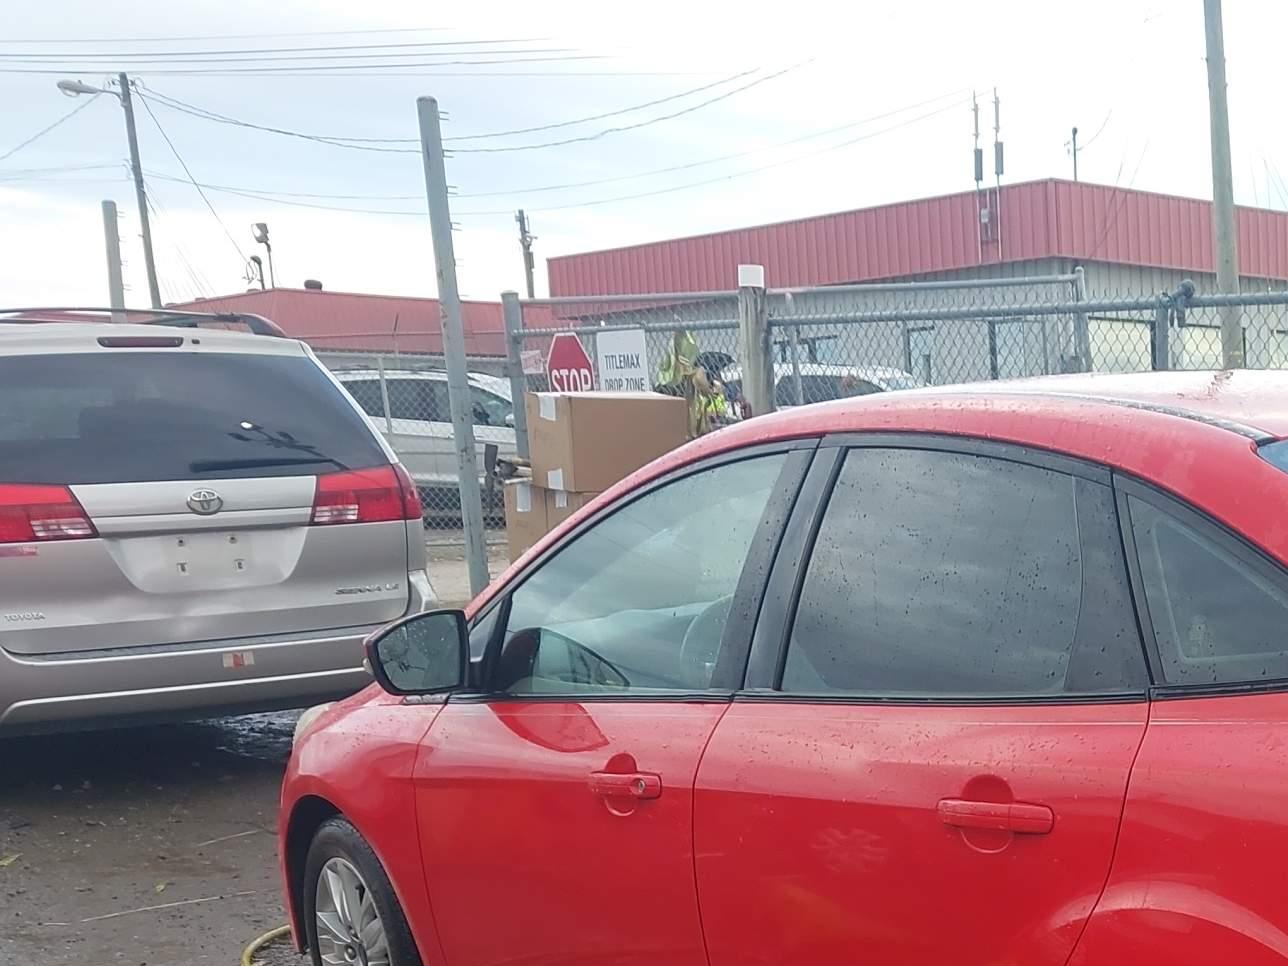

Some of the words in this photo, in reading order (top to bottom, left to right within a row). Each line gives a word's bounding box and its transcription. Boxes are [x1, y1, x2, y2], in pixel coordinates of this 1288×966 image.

[604, 353, 641, 370] TITLEMAX
[551, 368, 592, 392] STOP
[604, 378, 624, 392] DROP
[625, 376, 646, 392] ZONE
[4, 612, 46, 622] TOYOTA
